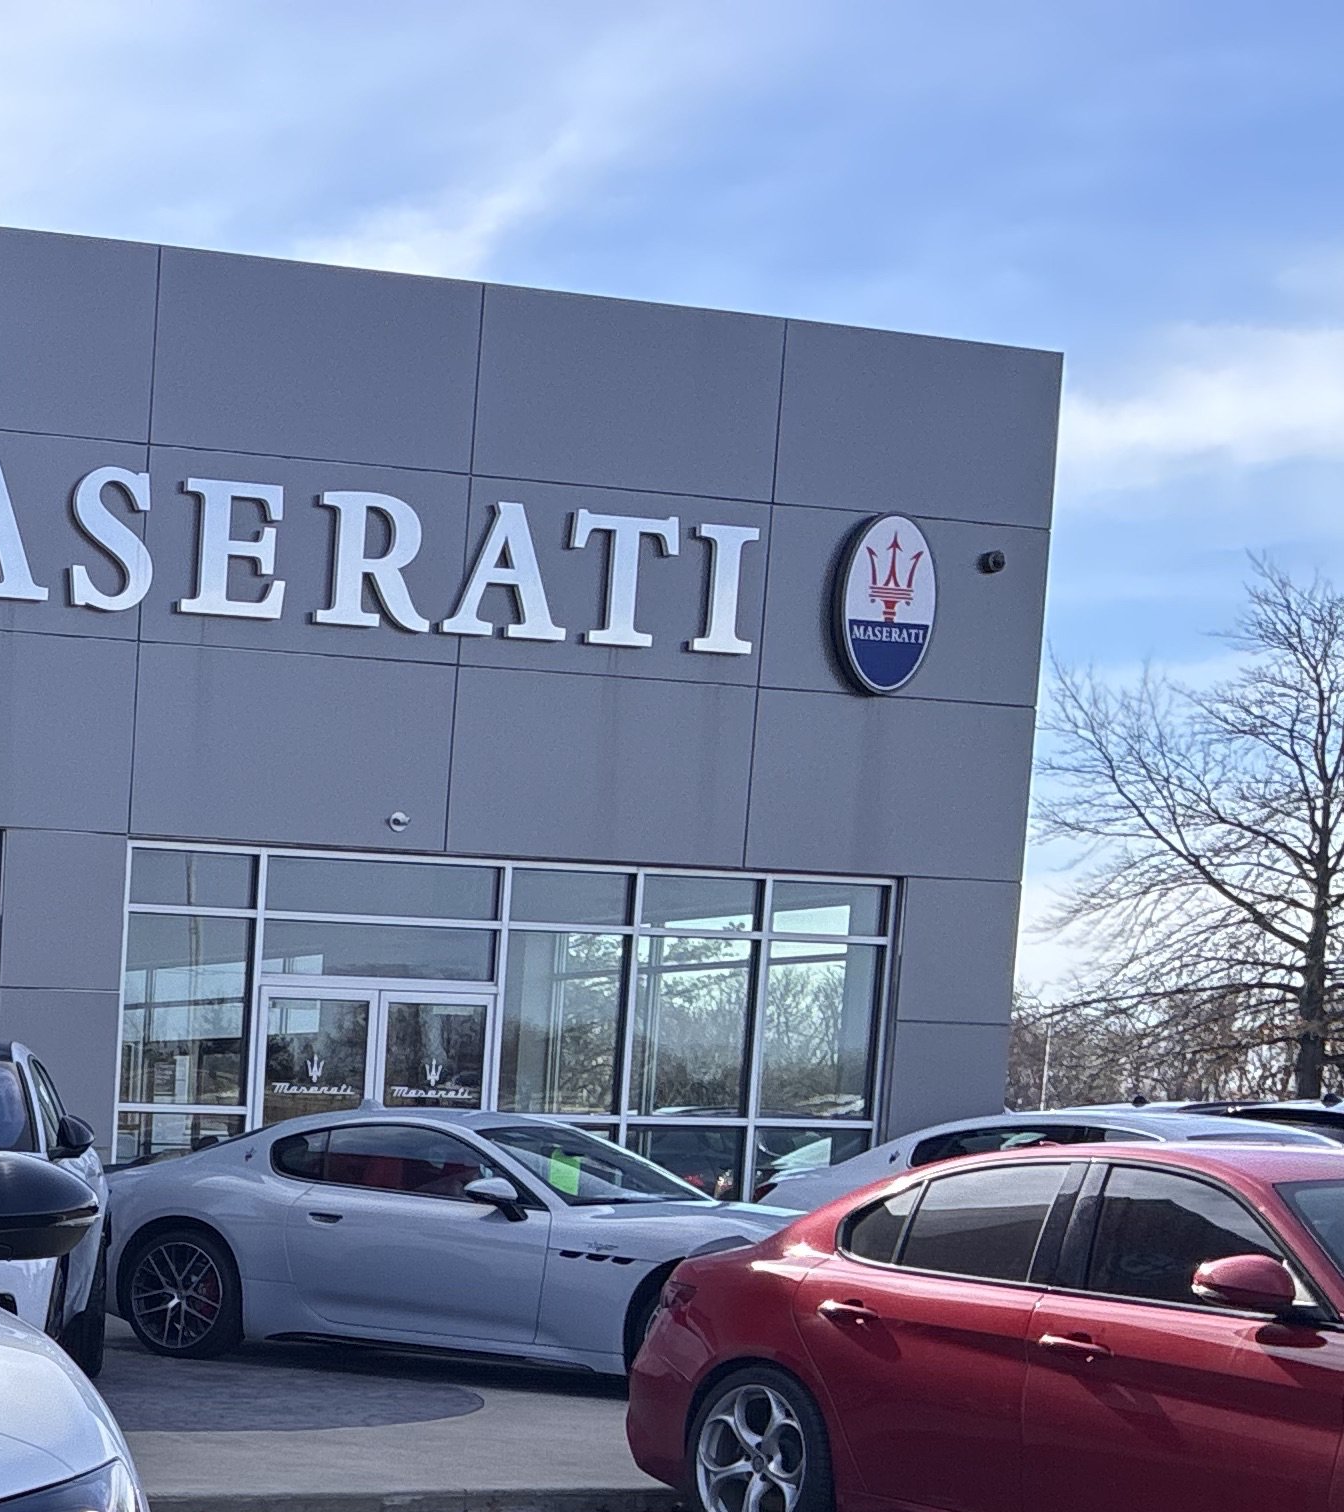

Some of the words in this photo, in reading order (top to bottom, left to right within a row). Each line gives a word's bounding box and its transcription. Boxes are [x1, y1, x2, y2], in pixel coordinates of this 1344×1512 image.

[852, 625, 924, 643] MASERATI
[272, 1081, 356, 1095] Maserati
[390, 1085, 473, 1099] Maserati
